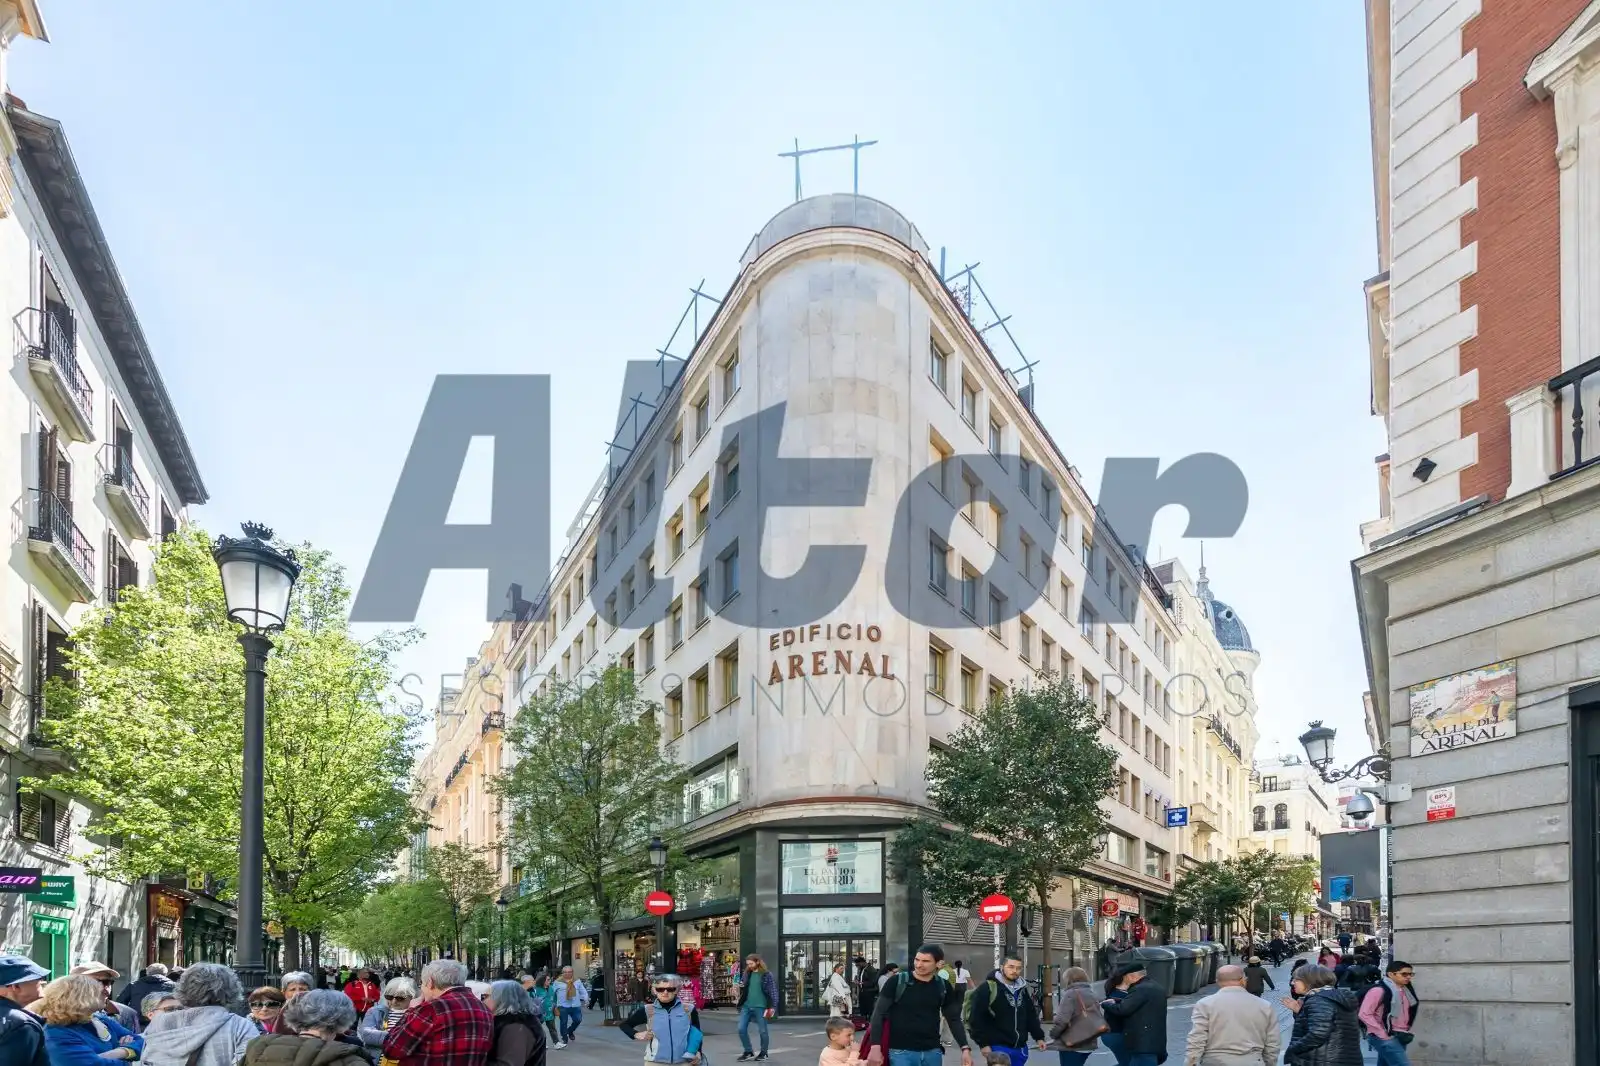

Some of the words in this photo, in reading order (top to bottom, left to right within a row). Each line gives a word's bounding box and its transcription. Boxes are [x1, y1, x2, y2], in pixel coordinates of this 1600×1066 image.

[769, 623, 882, 651] EDIFICIO
[768, 650, 896, 685] ARENAL
[1420, 726, 1506, 753] ARENAL
[1421, 721, 1474, 740] CALLE
[1477, 716, 1505, 727] DEL
[804, 868, 817, 876] EL
[810, 875, 855, 886] MADRID
